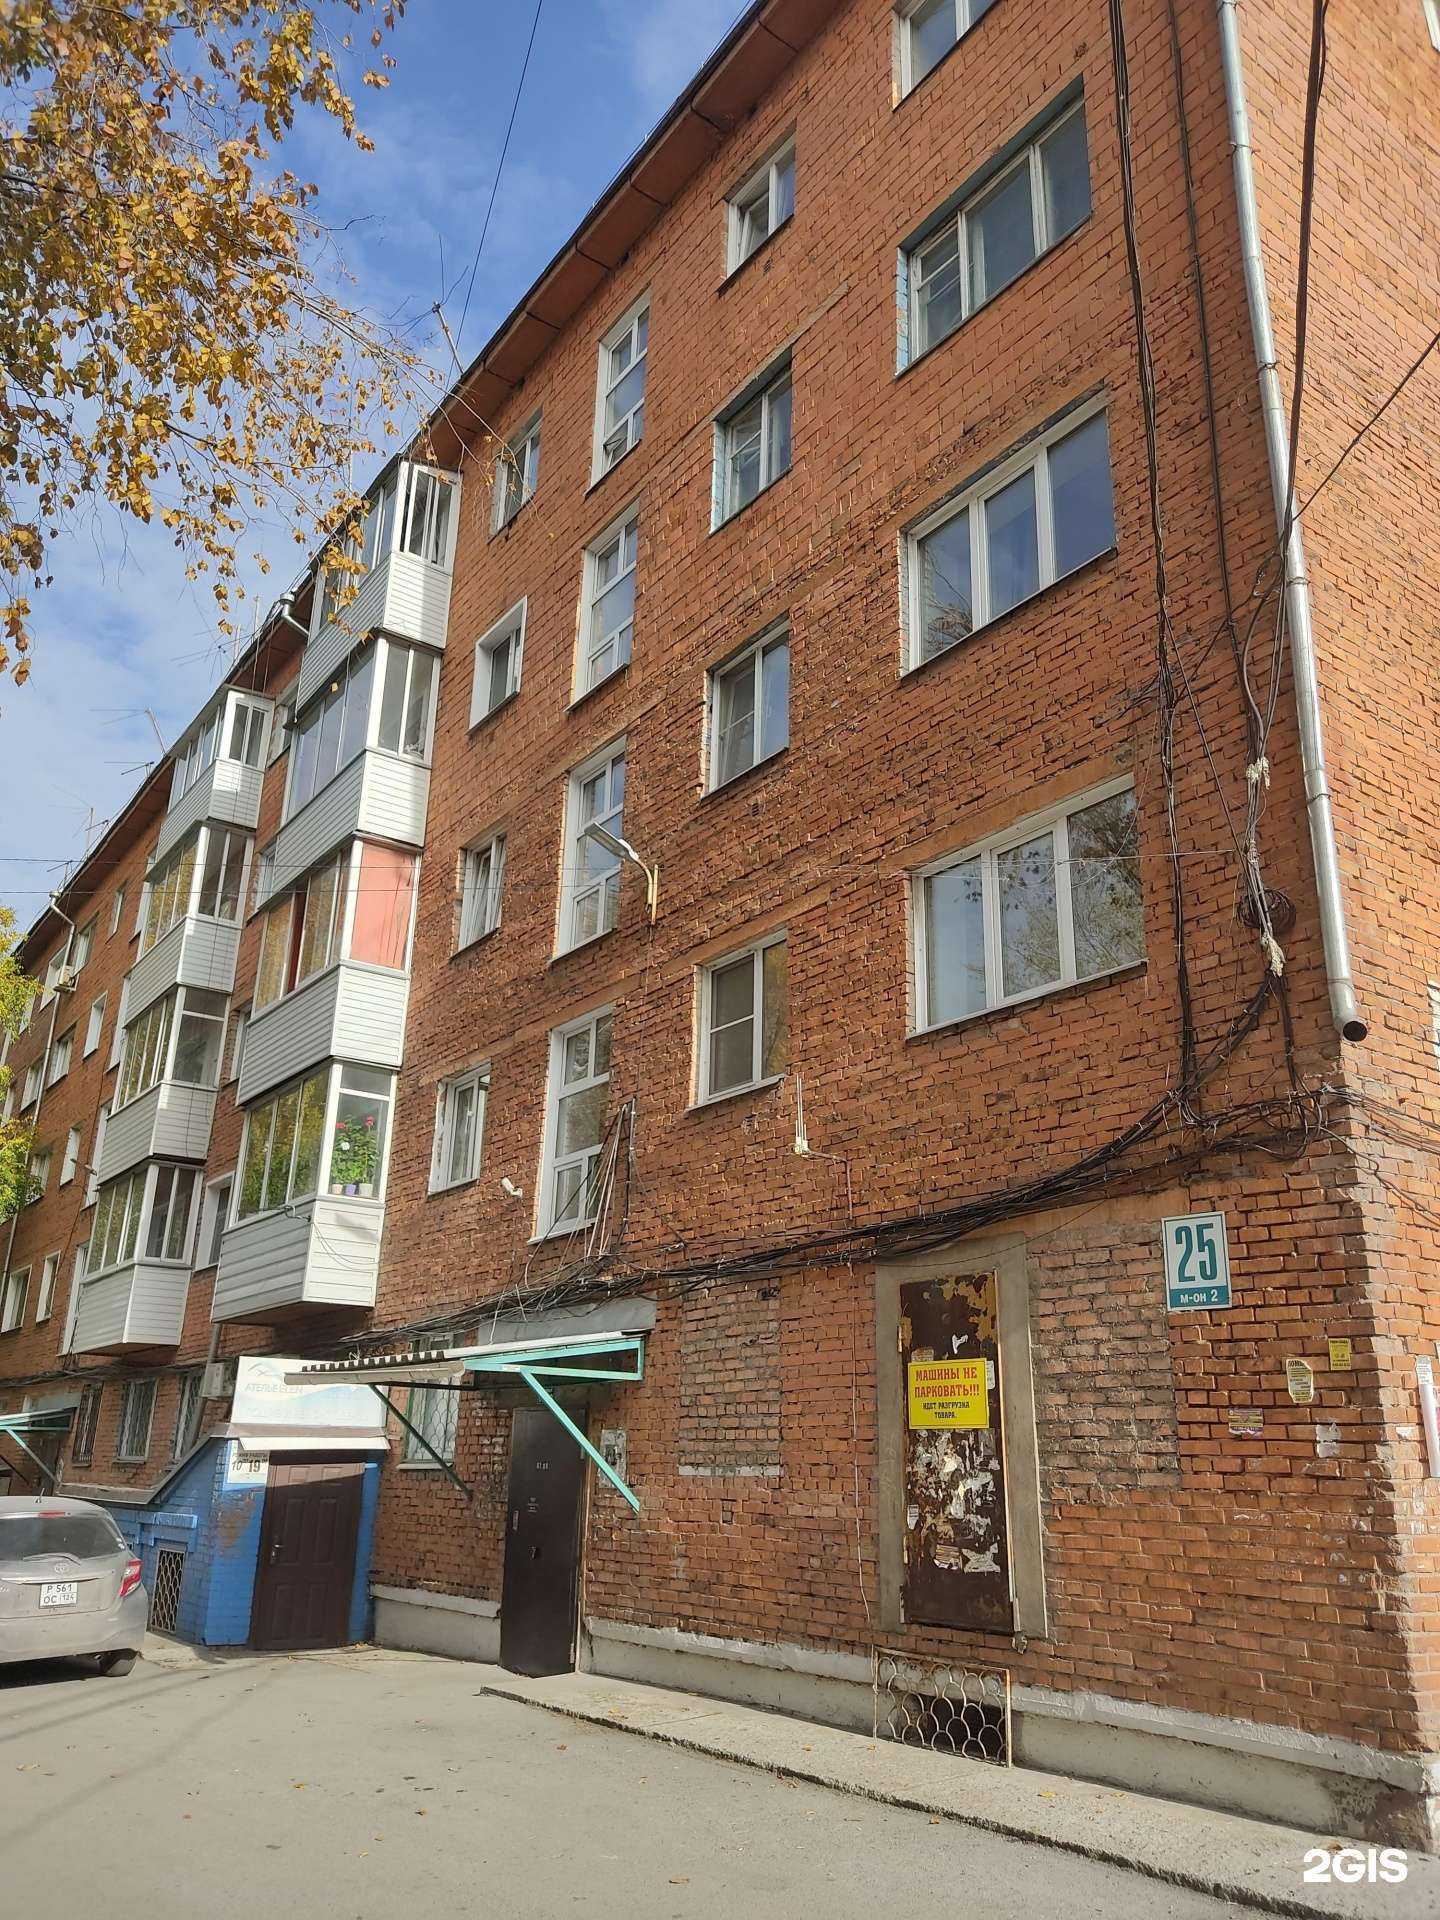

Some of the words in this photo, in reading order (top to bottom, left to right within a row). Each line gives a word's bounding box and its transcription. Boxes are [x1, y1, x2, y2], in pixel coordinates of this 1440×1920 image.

[1175, 1223, 1217, 1282] 25
[1211, 1289, 1218, 1302] 2
[916, 1368, 960, 1381] МАШИНЫ
[963, 1367, 977, 1379] НЕ
[915, 1384, 979, 1398] ПАРКОВАТЬ!!!
[923, 1402, 936, 1410] ИДЕТ
[938, 1401, 970, 1410] РАЗГРУЗКА
[47, 1585, 53, 1593] Р
[56, 1584, 72, 1592] 561
[44, 1596, 57, 1604] ОС
